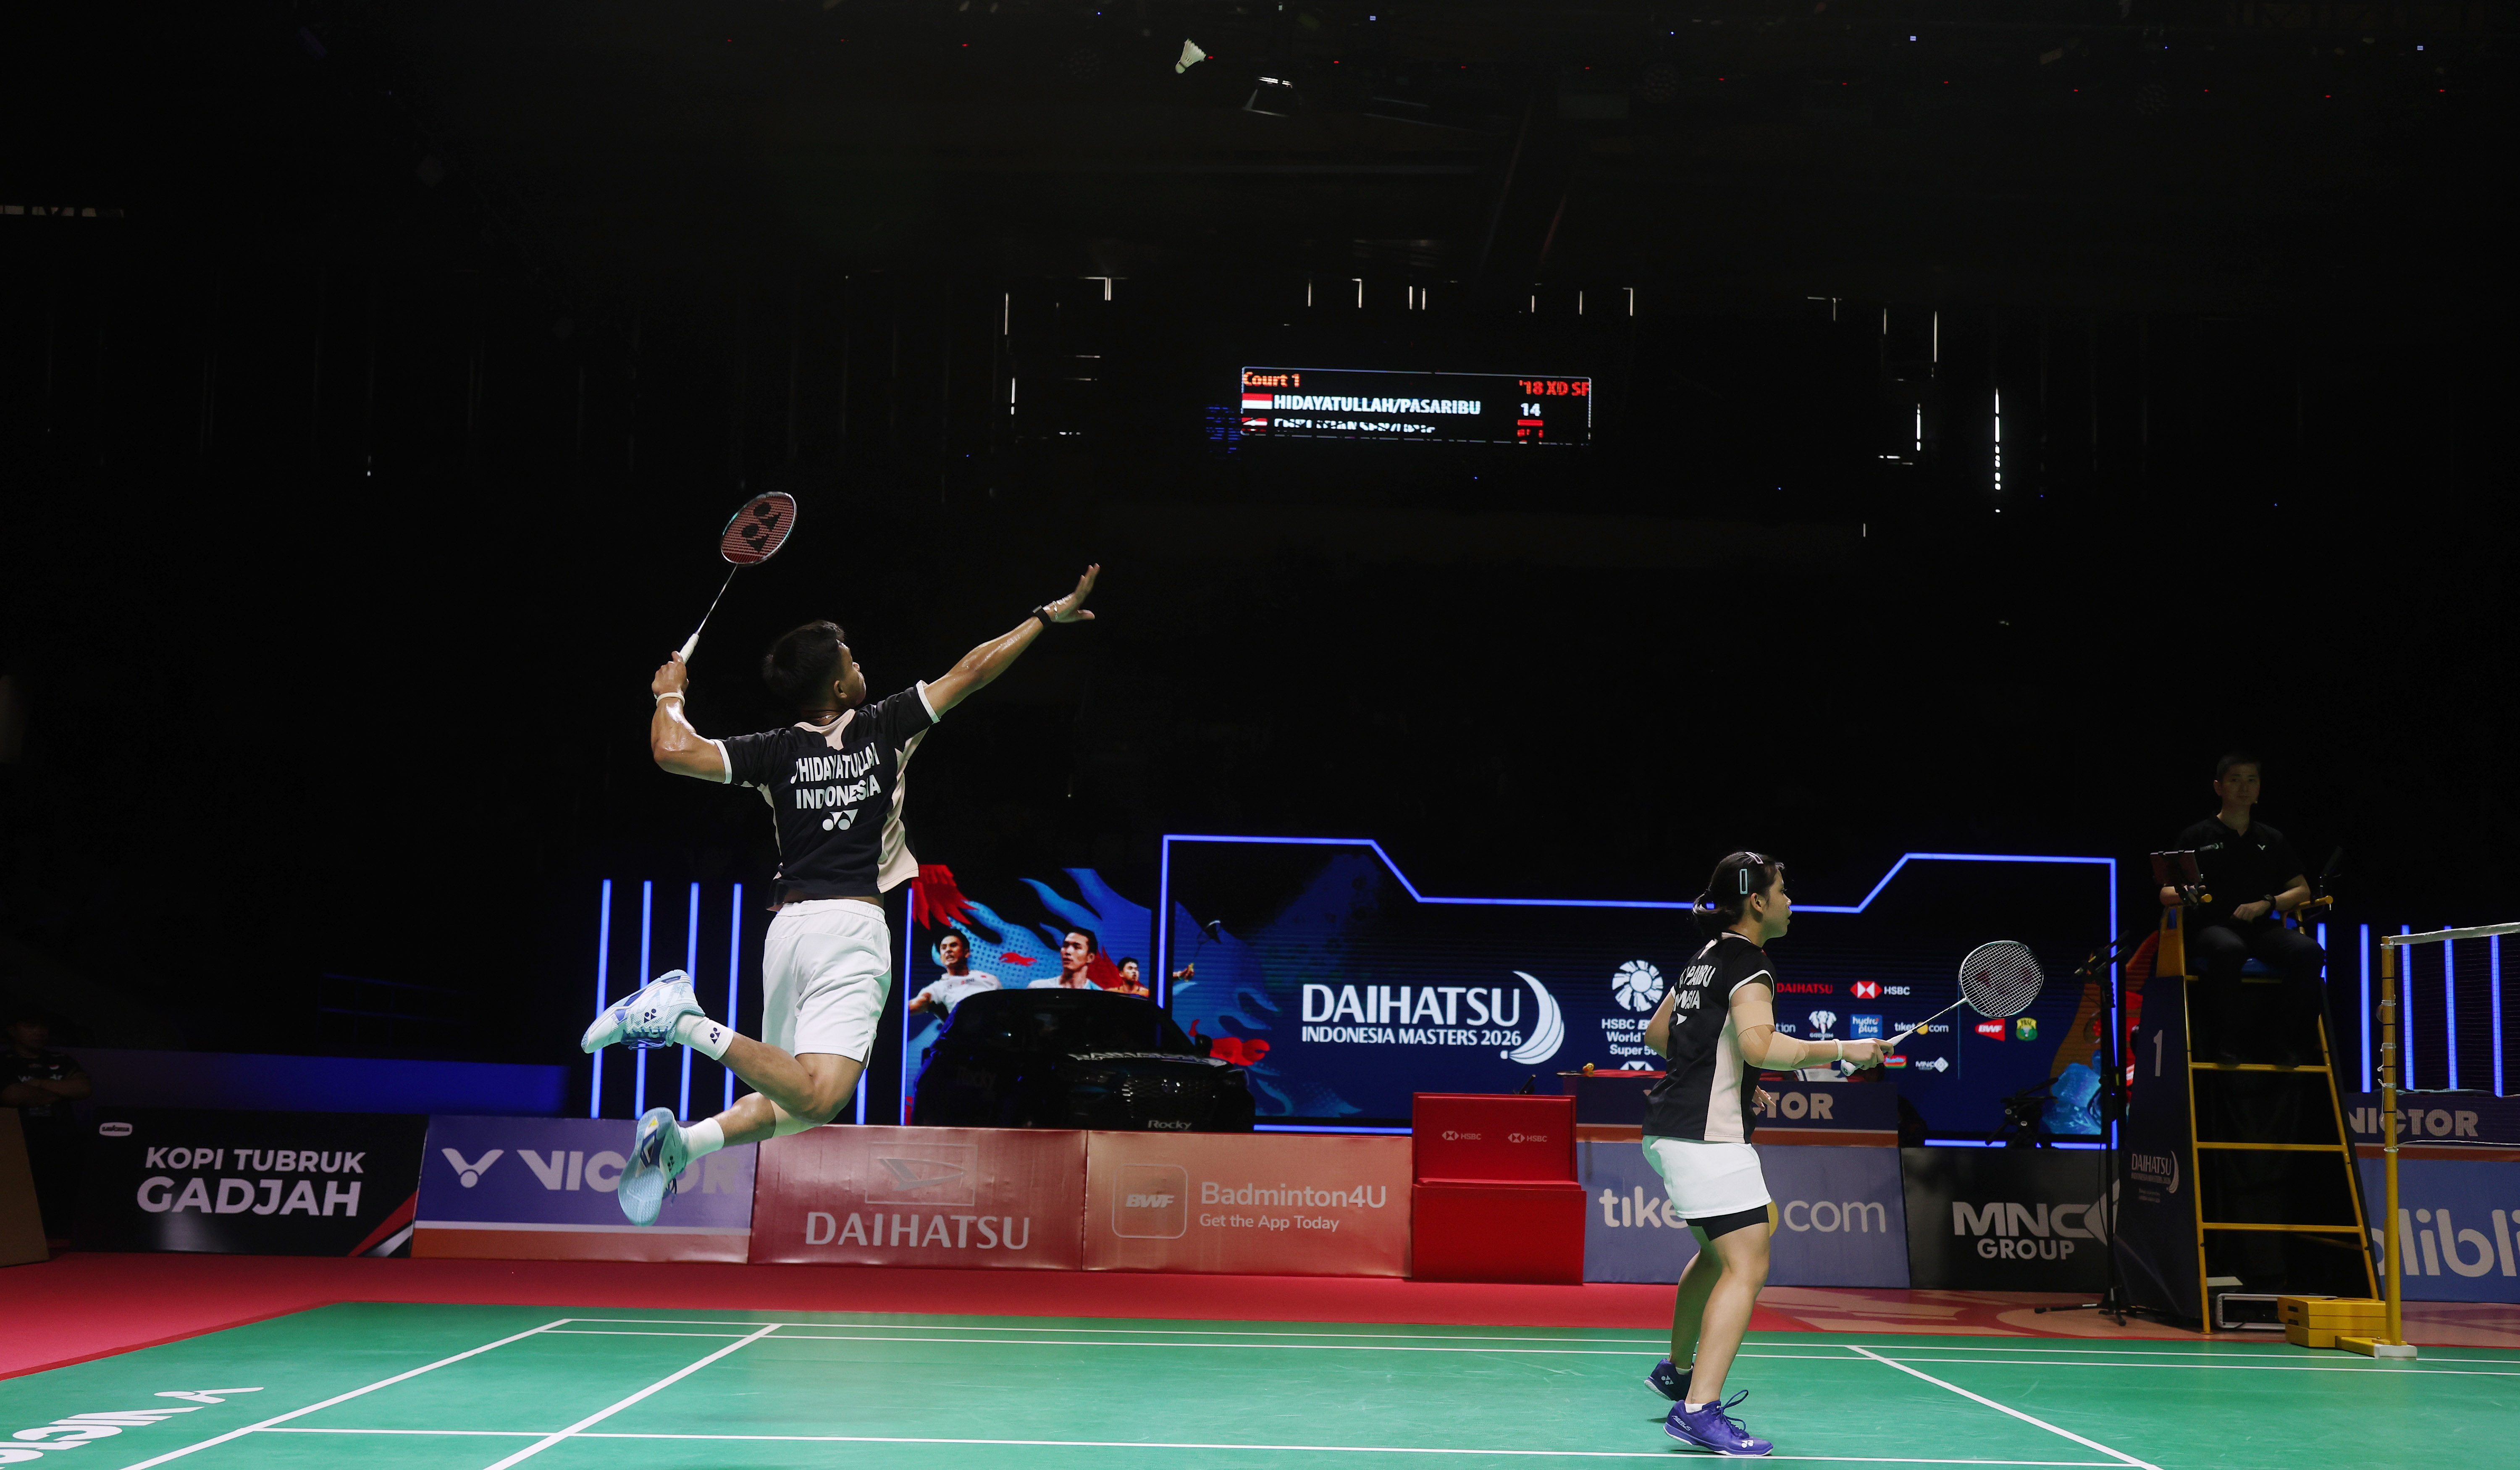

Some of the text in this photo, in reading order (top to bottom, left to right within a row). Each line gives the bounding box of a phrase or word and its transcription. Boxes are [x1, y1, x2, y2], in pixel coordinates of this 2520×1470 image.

[1243, 372, 1300, 387] Court 1
[1546, 381, 1569, 396] XD
[1571, 382, 1590, 396] SF
[1274, 394, 1481, 415] HIDAYATULLAH/PASARIBU
[1520, 402, 1541, 416] 14
[796, 774, 882, 809] INDONESIA
[1777, 983, 1833, 995] DAIHATSU
[1884, 986, 1910, 996] HSBC
[1302, 984, 1520, 1027] DAIHATSU
[1601, 1018, 1635, 1030] HSBC
[1852, 1016, 1879, 1027] hydro
[1858, 1025, 1878, 1034] plus
[1978, 1024, 2003, 1033] BWF
[1302, 1026, 1522, 1047] INDONESIA MASTERS 2026
[1606, 1031, 1641, 1043] World
[1609, 1044, 1643, 1057] Super
[2153, 1029, 2163, 1076] 1
[1148, 1120, 1192, 1130] Rocky
[145, 1147, 366, 1173] KOPI TUBRUK
[2132, 1153, 2172, 1175] DAIHATSU
[517, 1148, 740, 1195] VICOR
[136, 1176, 362, 1217] GADJAH
[1126, 1194, 1175, 1208] BWF
[1201, 1181, 1386, 1208] Badminton4U
[1200, 1214, 1339, 1232] Get the App Today
[1952, 1202, 2095, 1238] MNC
[806, 1211, 1030, 1250] DAIHATSU
[1977, 1238, 2075, 1260] GROUP
[1671, 1415, 1692, 1431] AERUS
